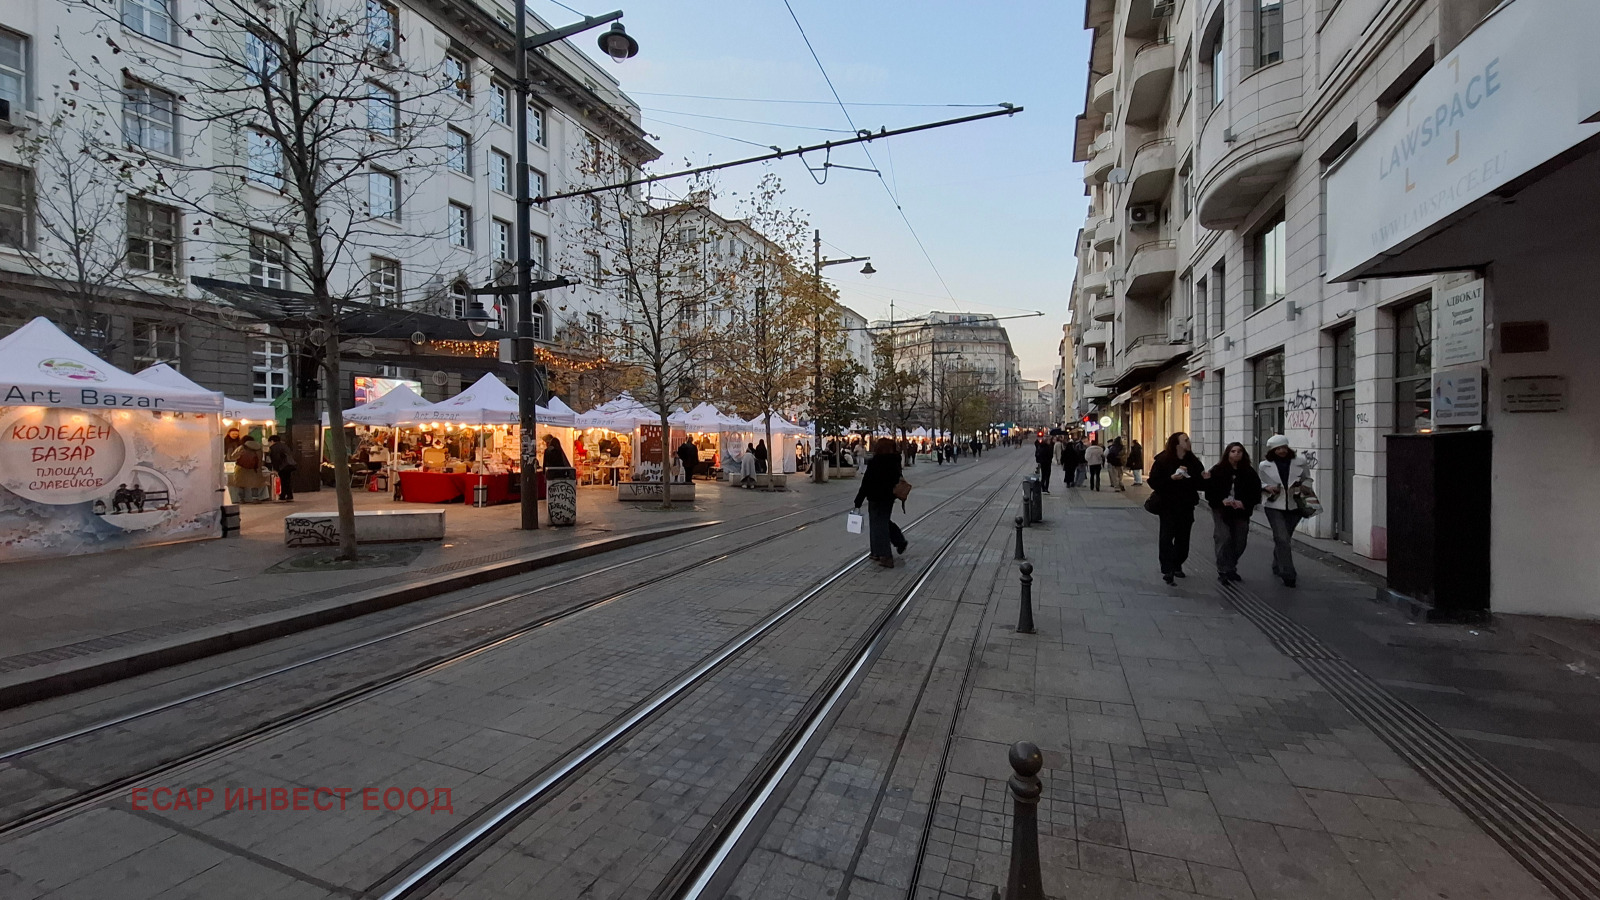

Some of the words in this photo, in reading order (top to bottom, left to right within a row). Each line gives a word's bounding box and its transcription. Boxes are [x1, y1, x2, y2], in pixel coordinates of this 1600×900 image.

[1380, 57, 1502, 180] LAWSPACE
[1446, 287, 1482, 307] АДВОКАТ
[4, 385, 61, 404] Art
[81, 389, 165, 408] Bazar
[432, 411, 460, 420] Bazar
[12, 425, 111, 445] КОЛЕДЕН
[31, 446, 95, 463] БАЗАР
[36, 466, 94, 479] ПЛОЩАД
[28, 477, 104, 491] СЛАВЕЙКОВ
